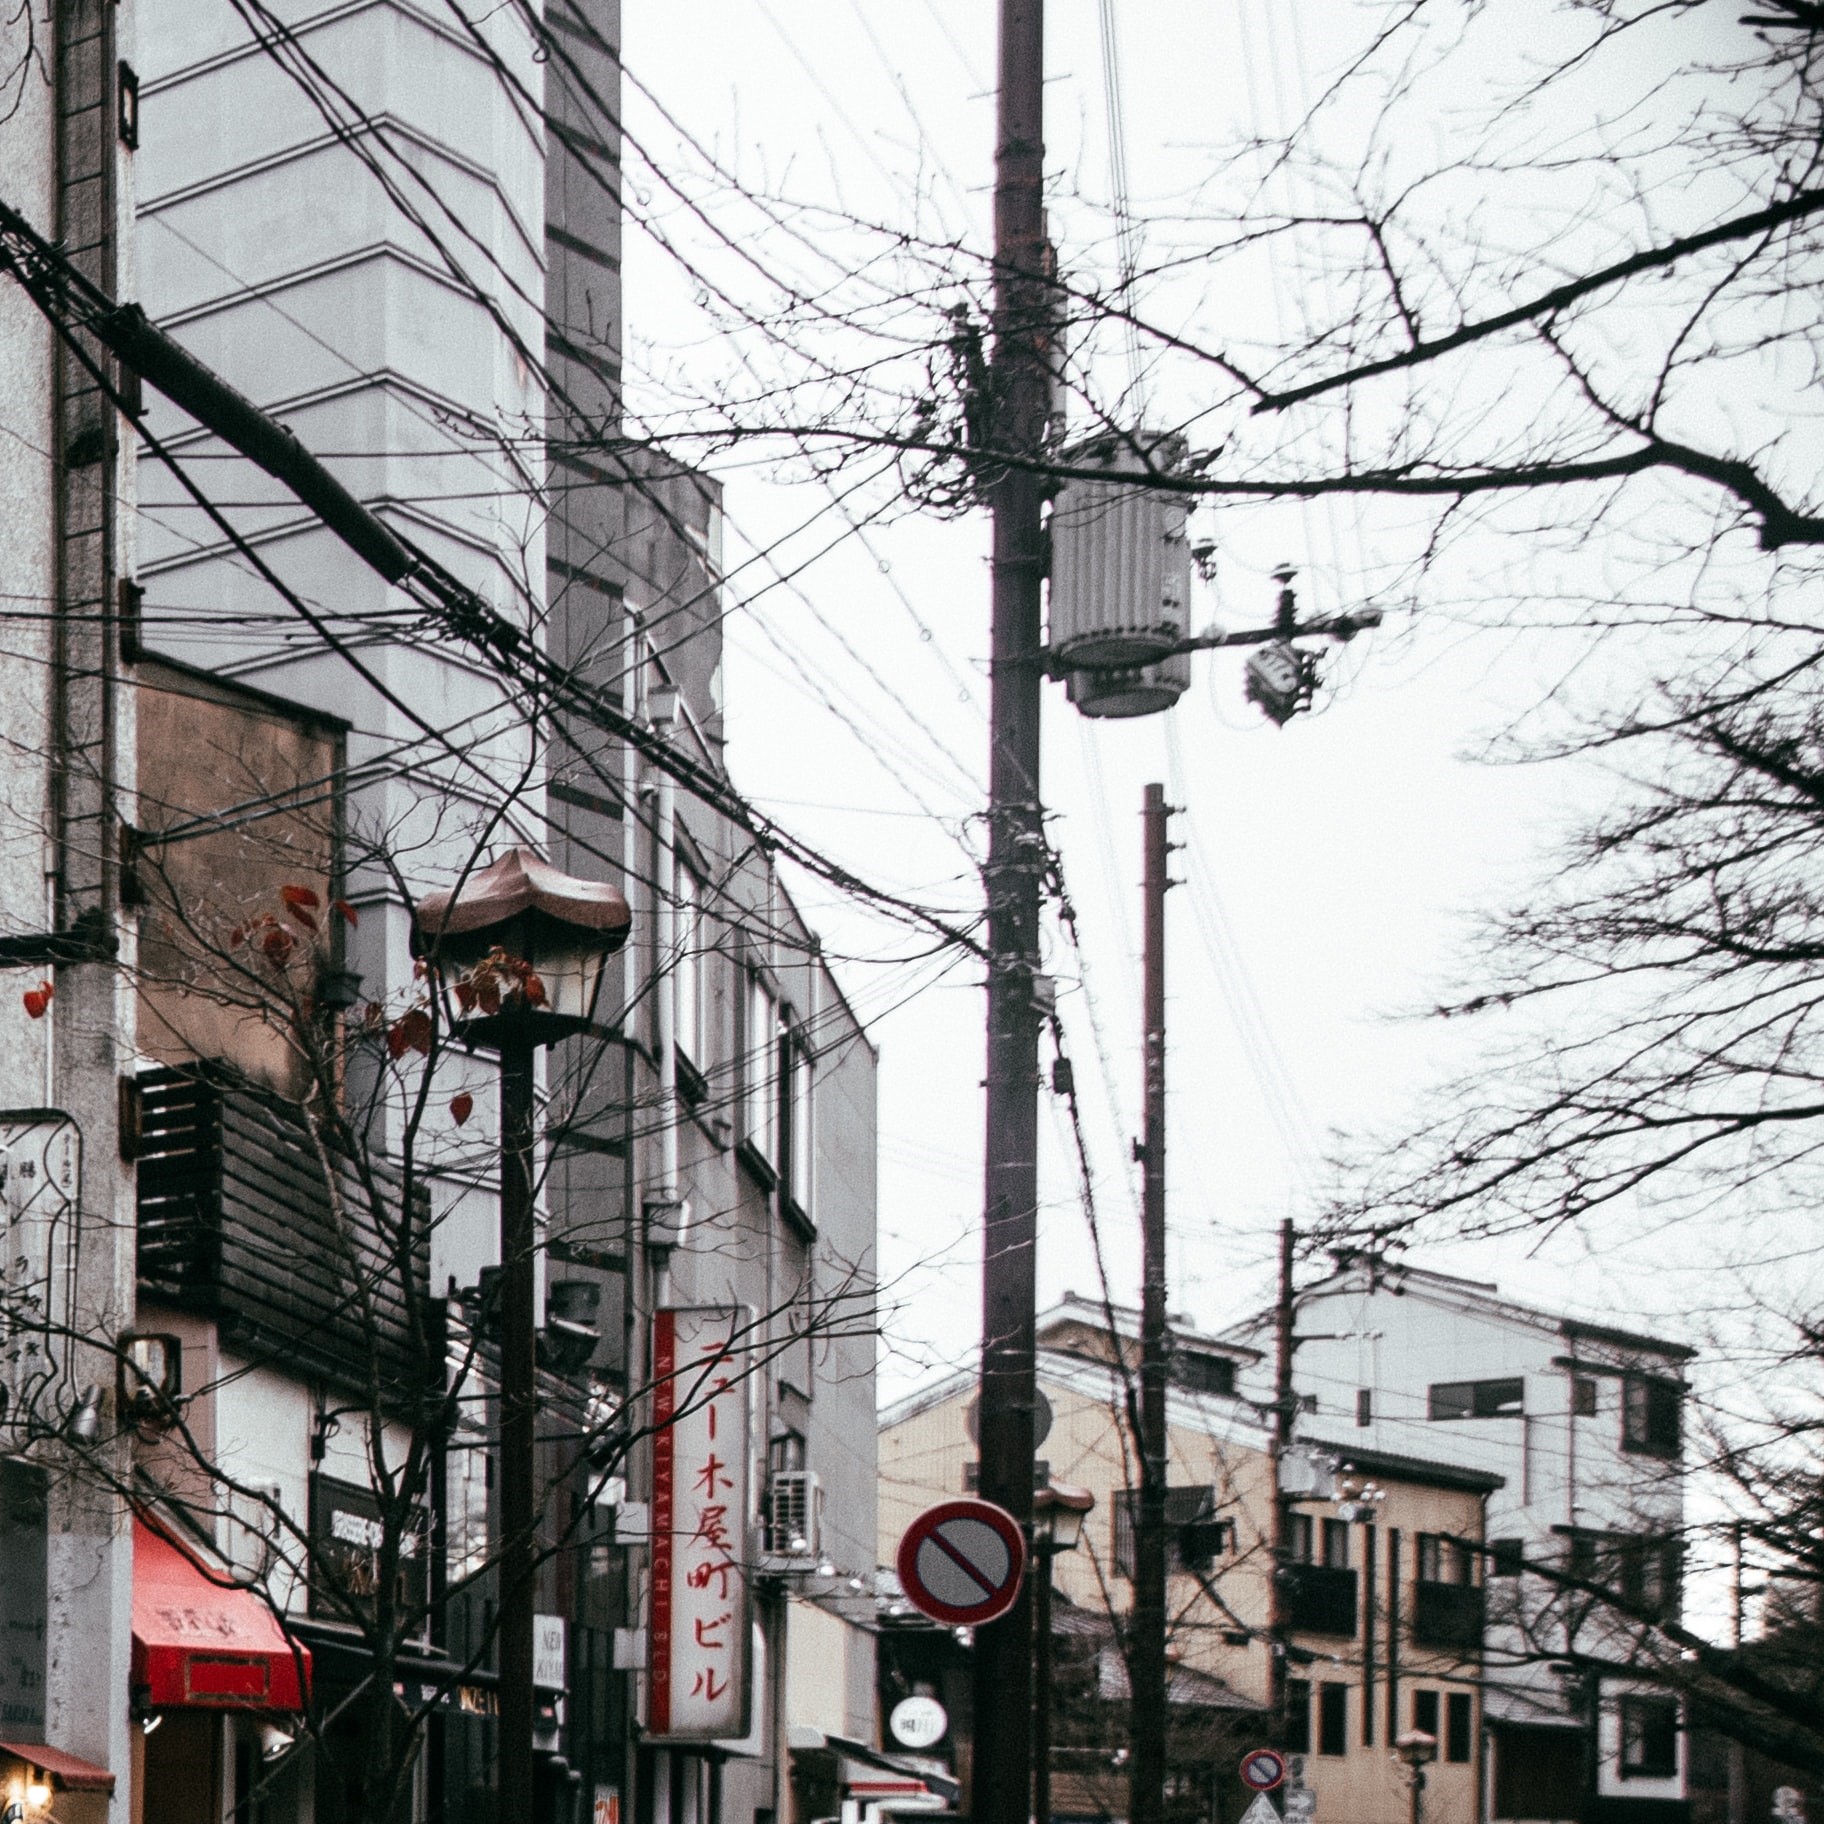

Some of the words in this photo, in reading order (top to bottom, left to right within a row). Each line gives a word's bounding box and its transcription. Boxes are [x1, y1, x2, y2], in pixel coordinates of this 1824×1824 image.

[685, 1340, 736, 1702] ニュー木屋町ビル
